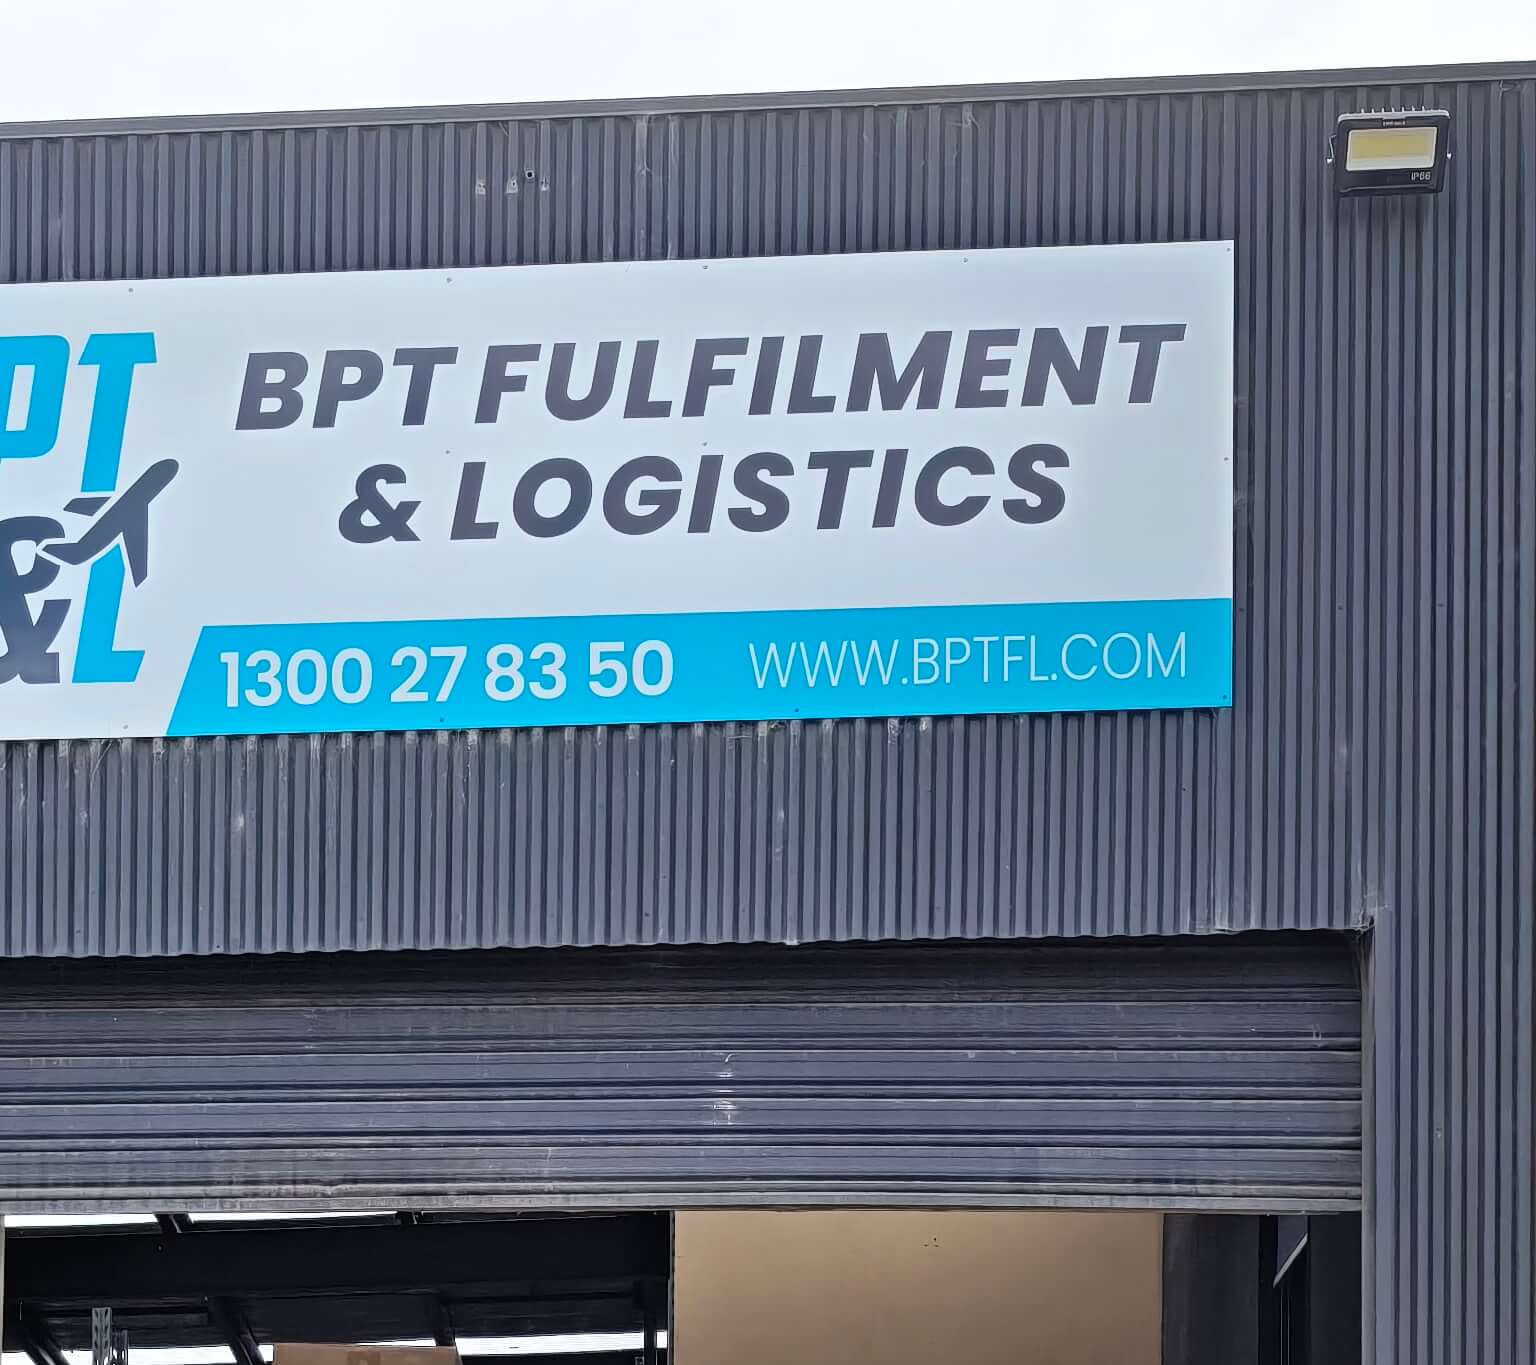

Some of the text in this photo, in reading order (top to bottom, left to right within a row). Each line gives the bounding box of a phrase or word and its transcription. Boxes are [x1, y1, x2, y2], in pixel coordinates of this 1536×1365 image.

[234, 322, 1187, 430] BPT FULFILMENT
[338, 442, 1072, 544] & LOGISTICS
[220, 639, 675, 707] 1300 27 83 50
[749, 632, 1187, 688] WWW.BPTFL.COM
